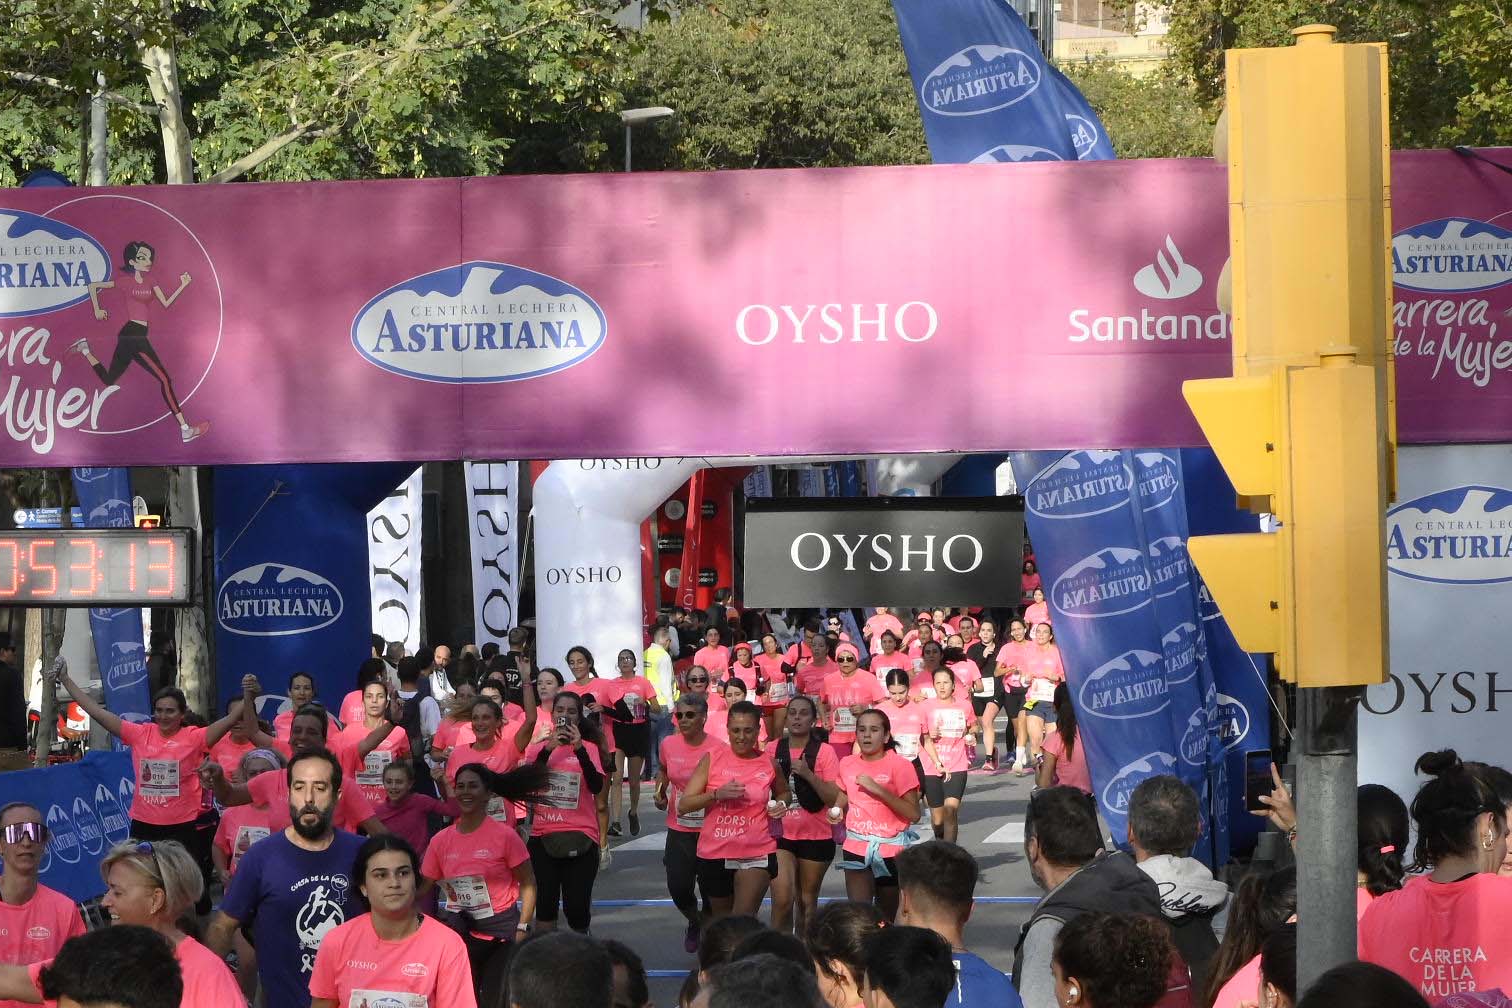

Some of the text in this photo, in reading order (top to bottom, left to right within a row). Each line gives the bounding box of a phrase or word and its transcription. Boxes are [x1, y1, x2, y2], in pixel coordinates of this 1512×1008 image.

[13, 246, 86, 257] LECHERA
[411, 302, 578, 317] CENTRAL LECHERA
[735, 301, 938, 346] OYSHO
[1393, 298, 1489, 328] arrera
[370, 309, 588, 354] ASTURIANA
[1068, 308, 1232, 342] Santand
[1418, 327, 1435, 356] la
[1431, 322, 1512, 388] Muje
[1415, 520, 1483, 531] CENTRAL
[790, 532, 984, 574] OYSHO
[546, 565, 622, 585] OYSHO
[221, 592, 334, 620] ASTURIANA
[1360, 671, 1512, 715] OYSH
[347, 959, 378, 971] OYSHO
[1409, 945, 1488, 964] CARRERA
[1424, 964, 1474, 981] DE LA
